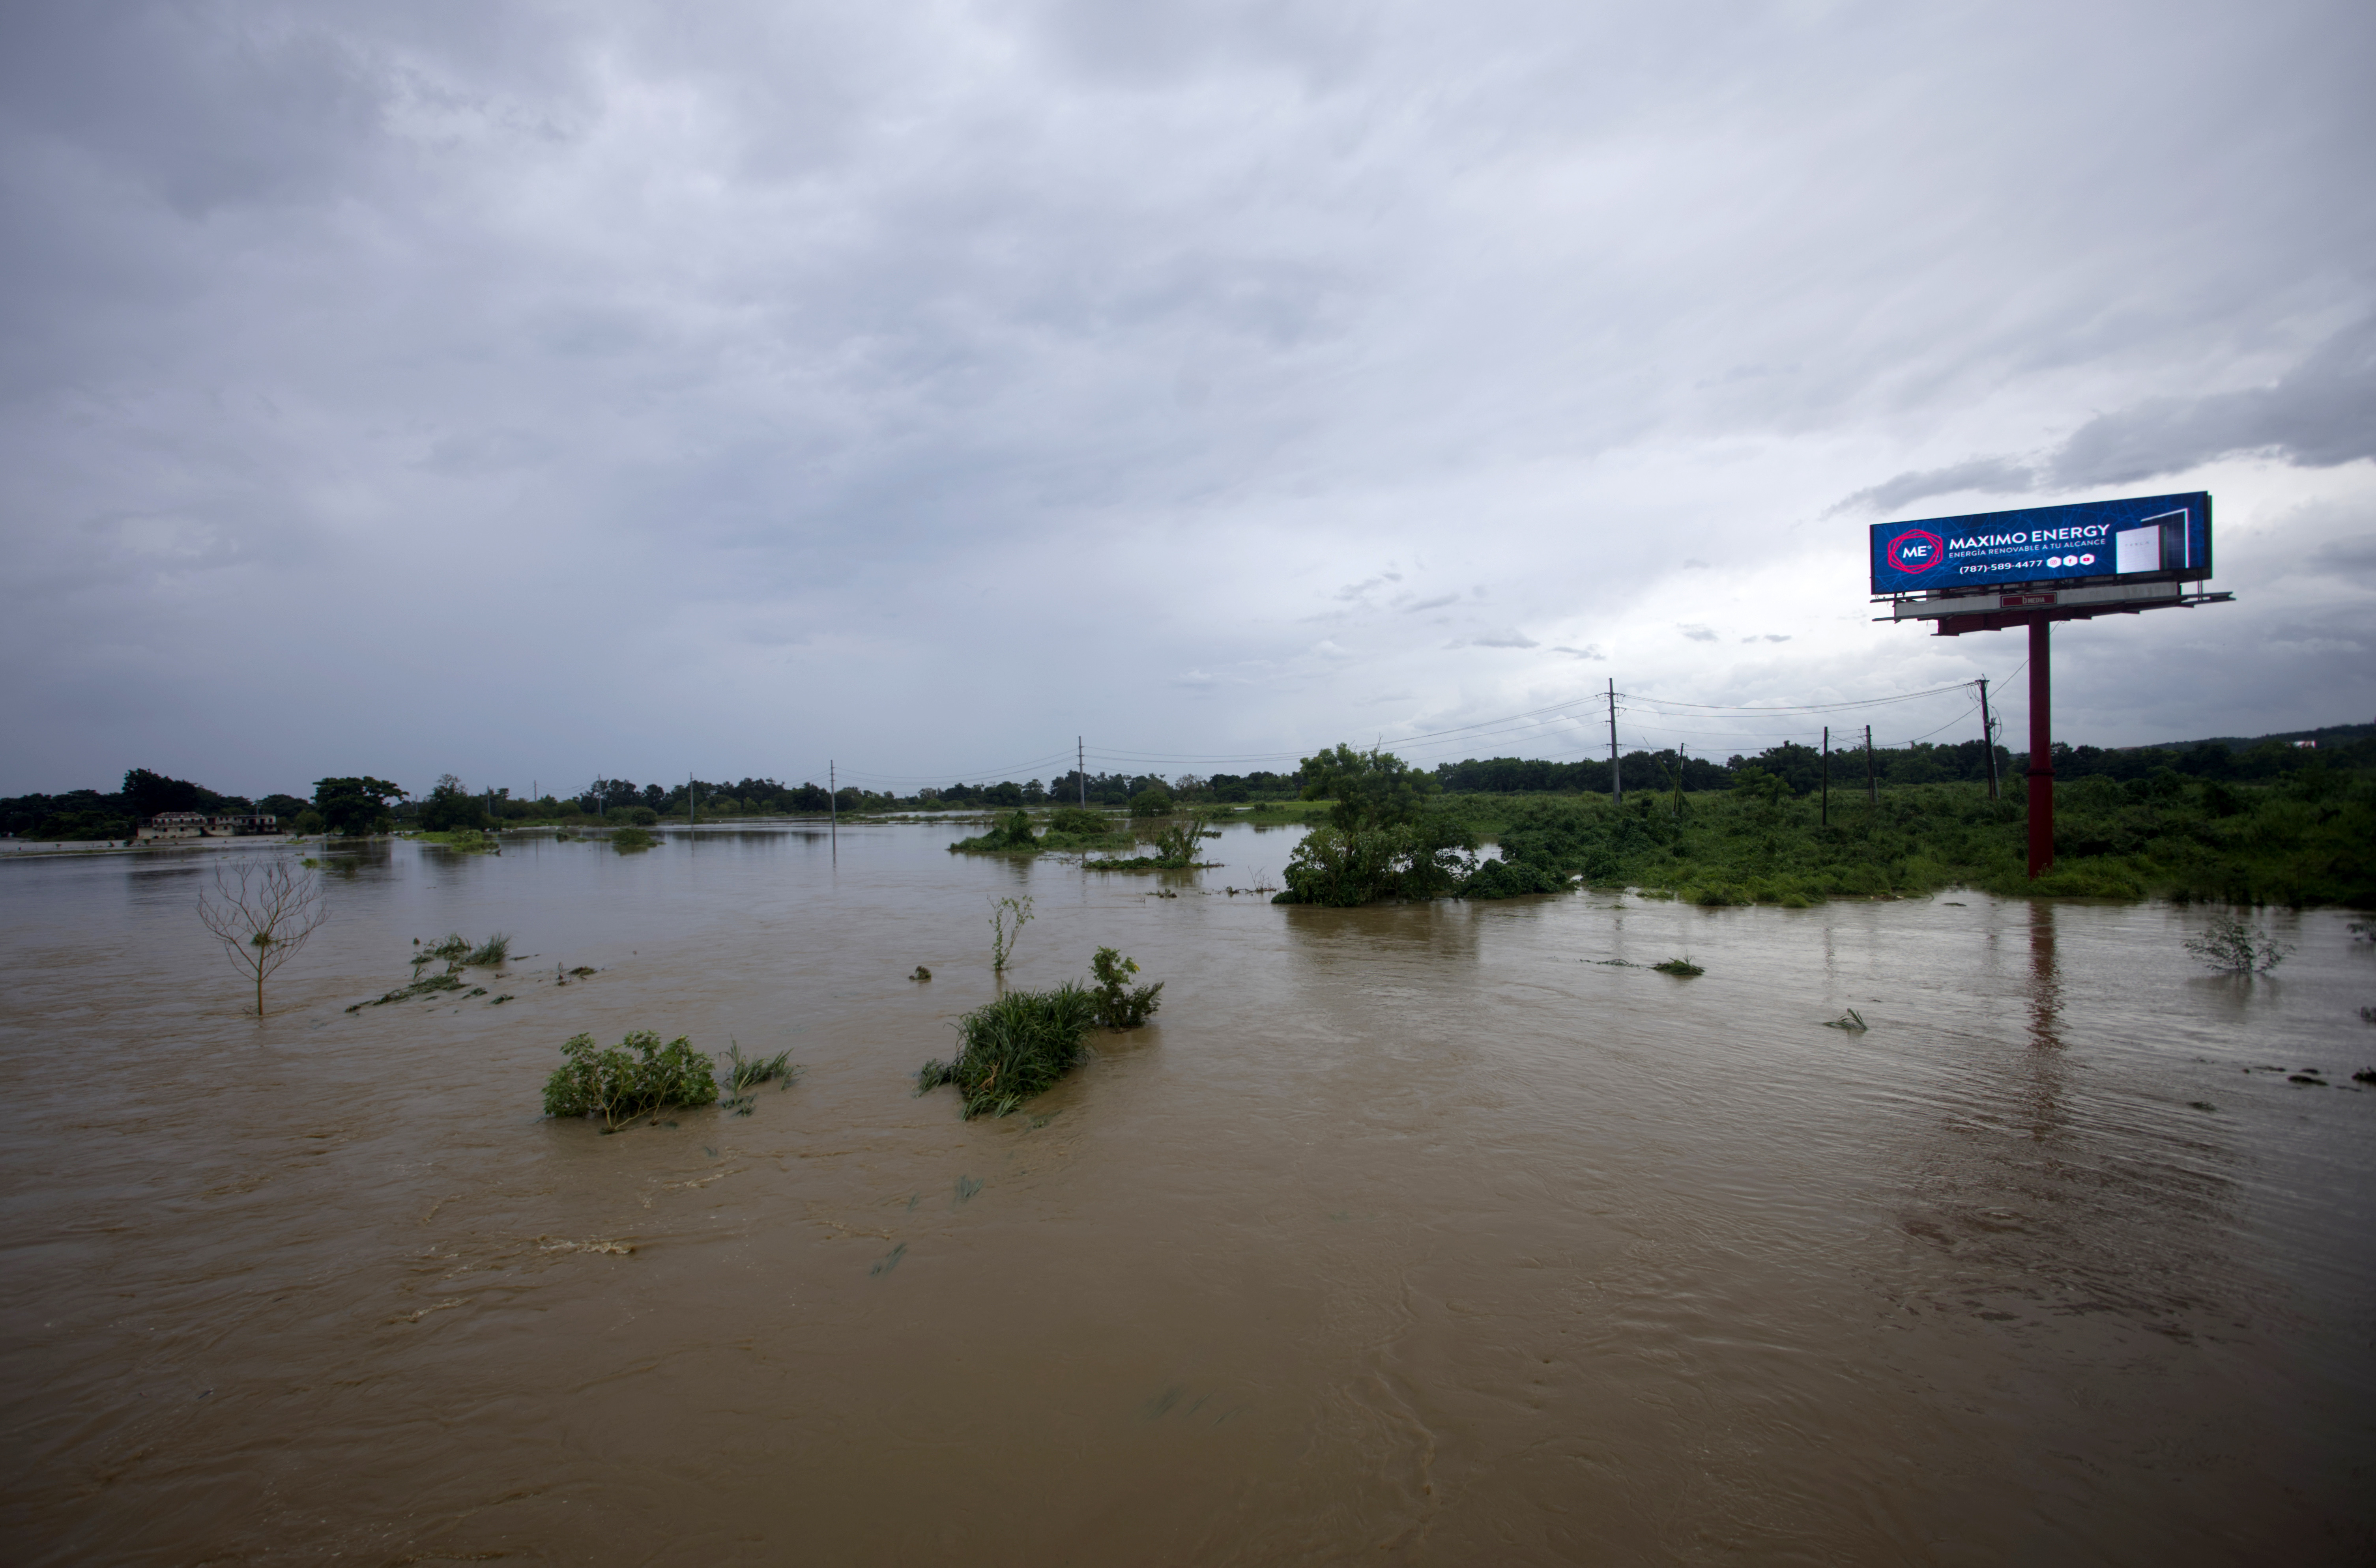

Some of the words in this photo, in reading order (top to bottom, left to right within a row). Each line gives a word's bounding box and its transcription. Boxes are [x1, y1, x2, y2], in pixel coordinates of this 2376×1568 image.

[1949, 532, 2027, 549] MAXIMO
[2032, 524, 2110, 542] ENERGY
[1949, 549, 1986, 558] ENERGÍA
[1989, 545, 2039, 554] RENOVABLE
[2064, 538, 2106, 548] ALCANCE
[1959, 560, 2043, 574] (787)-589-4477
